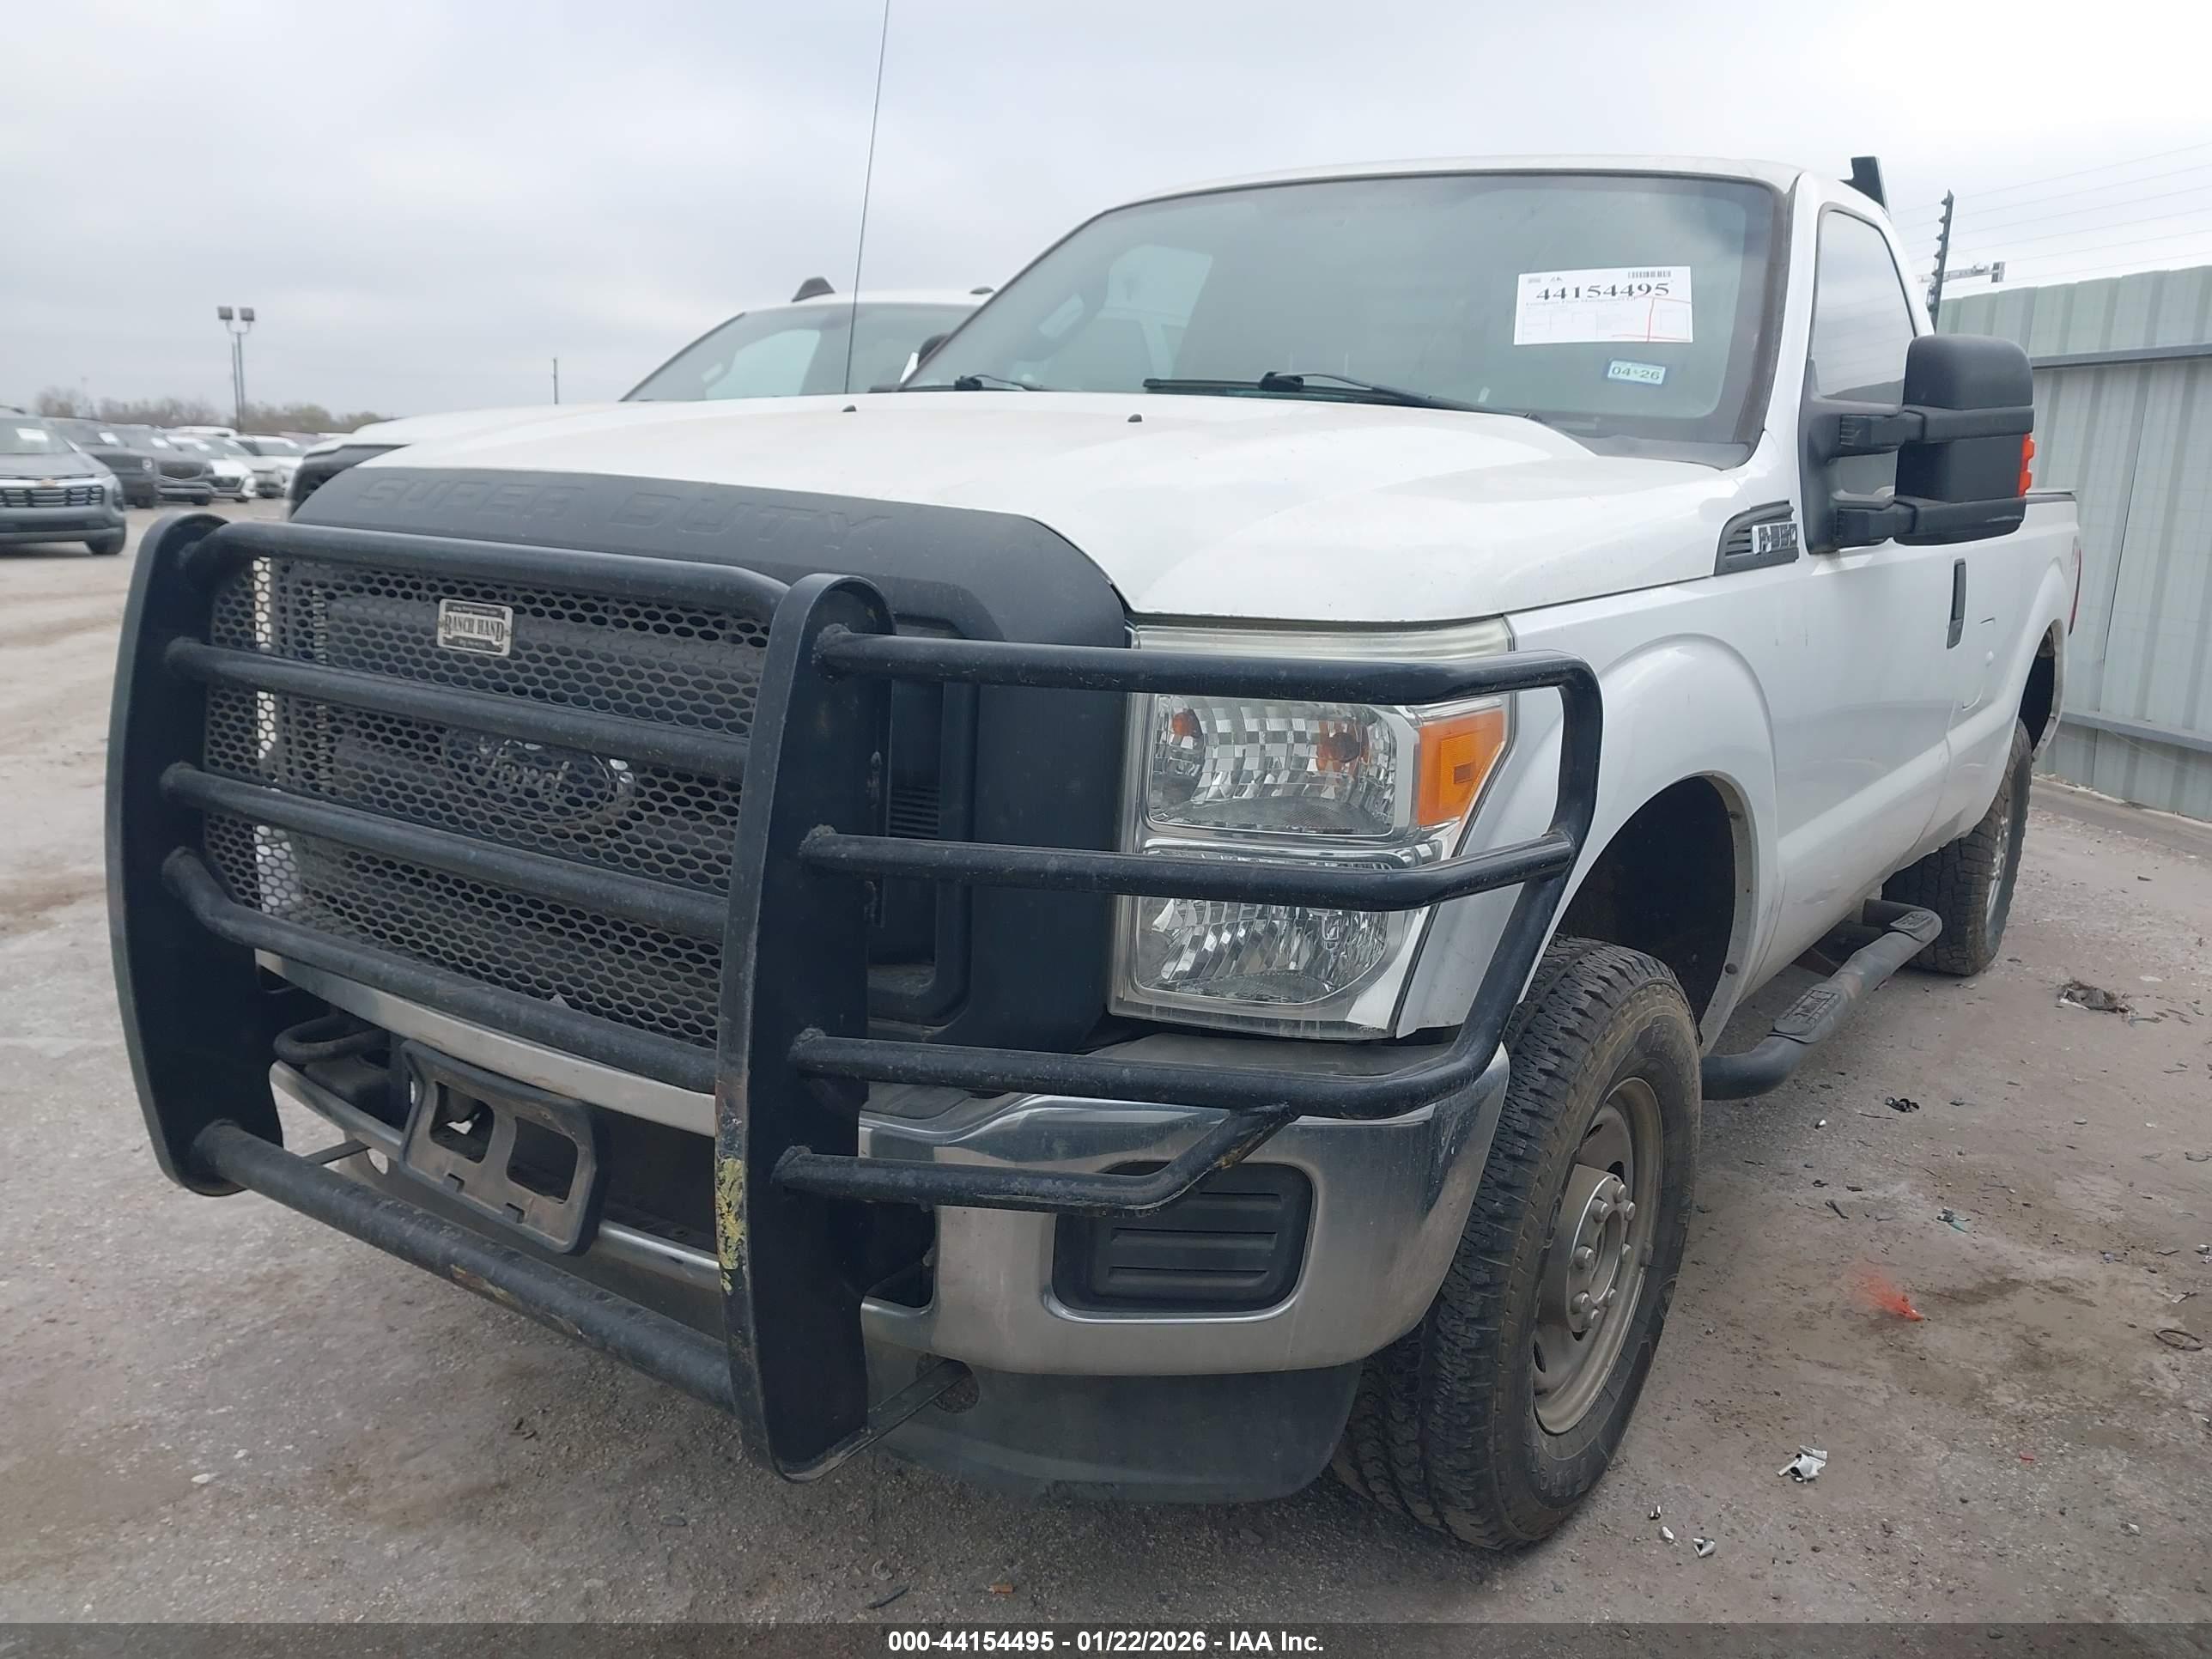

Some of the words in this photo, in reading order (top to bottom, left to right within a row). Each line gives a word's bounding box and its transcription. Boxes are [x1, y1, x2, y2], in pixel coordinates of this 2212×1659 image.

[1536, 283, 1669, 301] 44154495
[357, 477, 585, 520] SUPER
[608, 492, 894, 550] DUTY
[443, 614, 475, 635] RANCH
[477, 618, 505, 642] HAND
